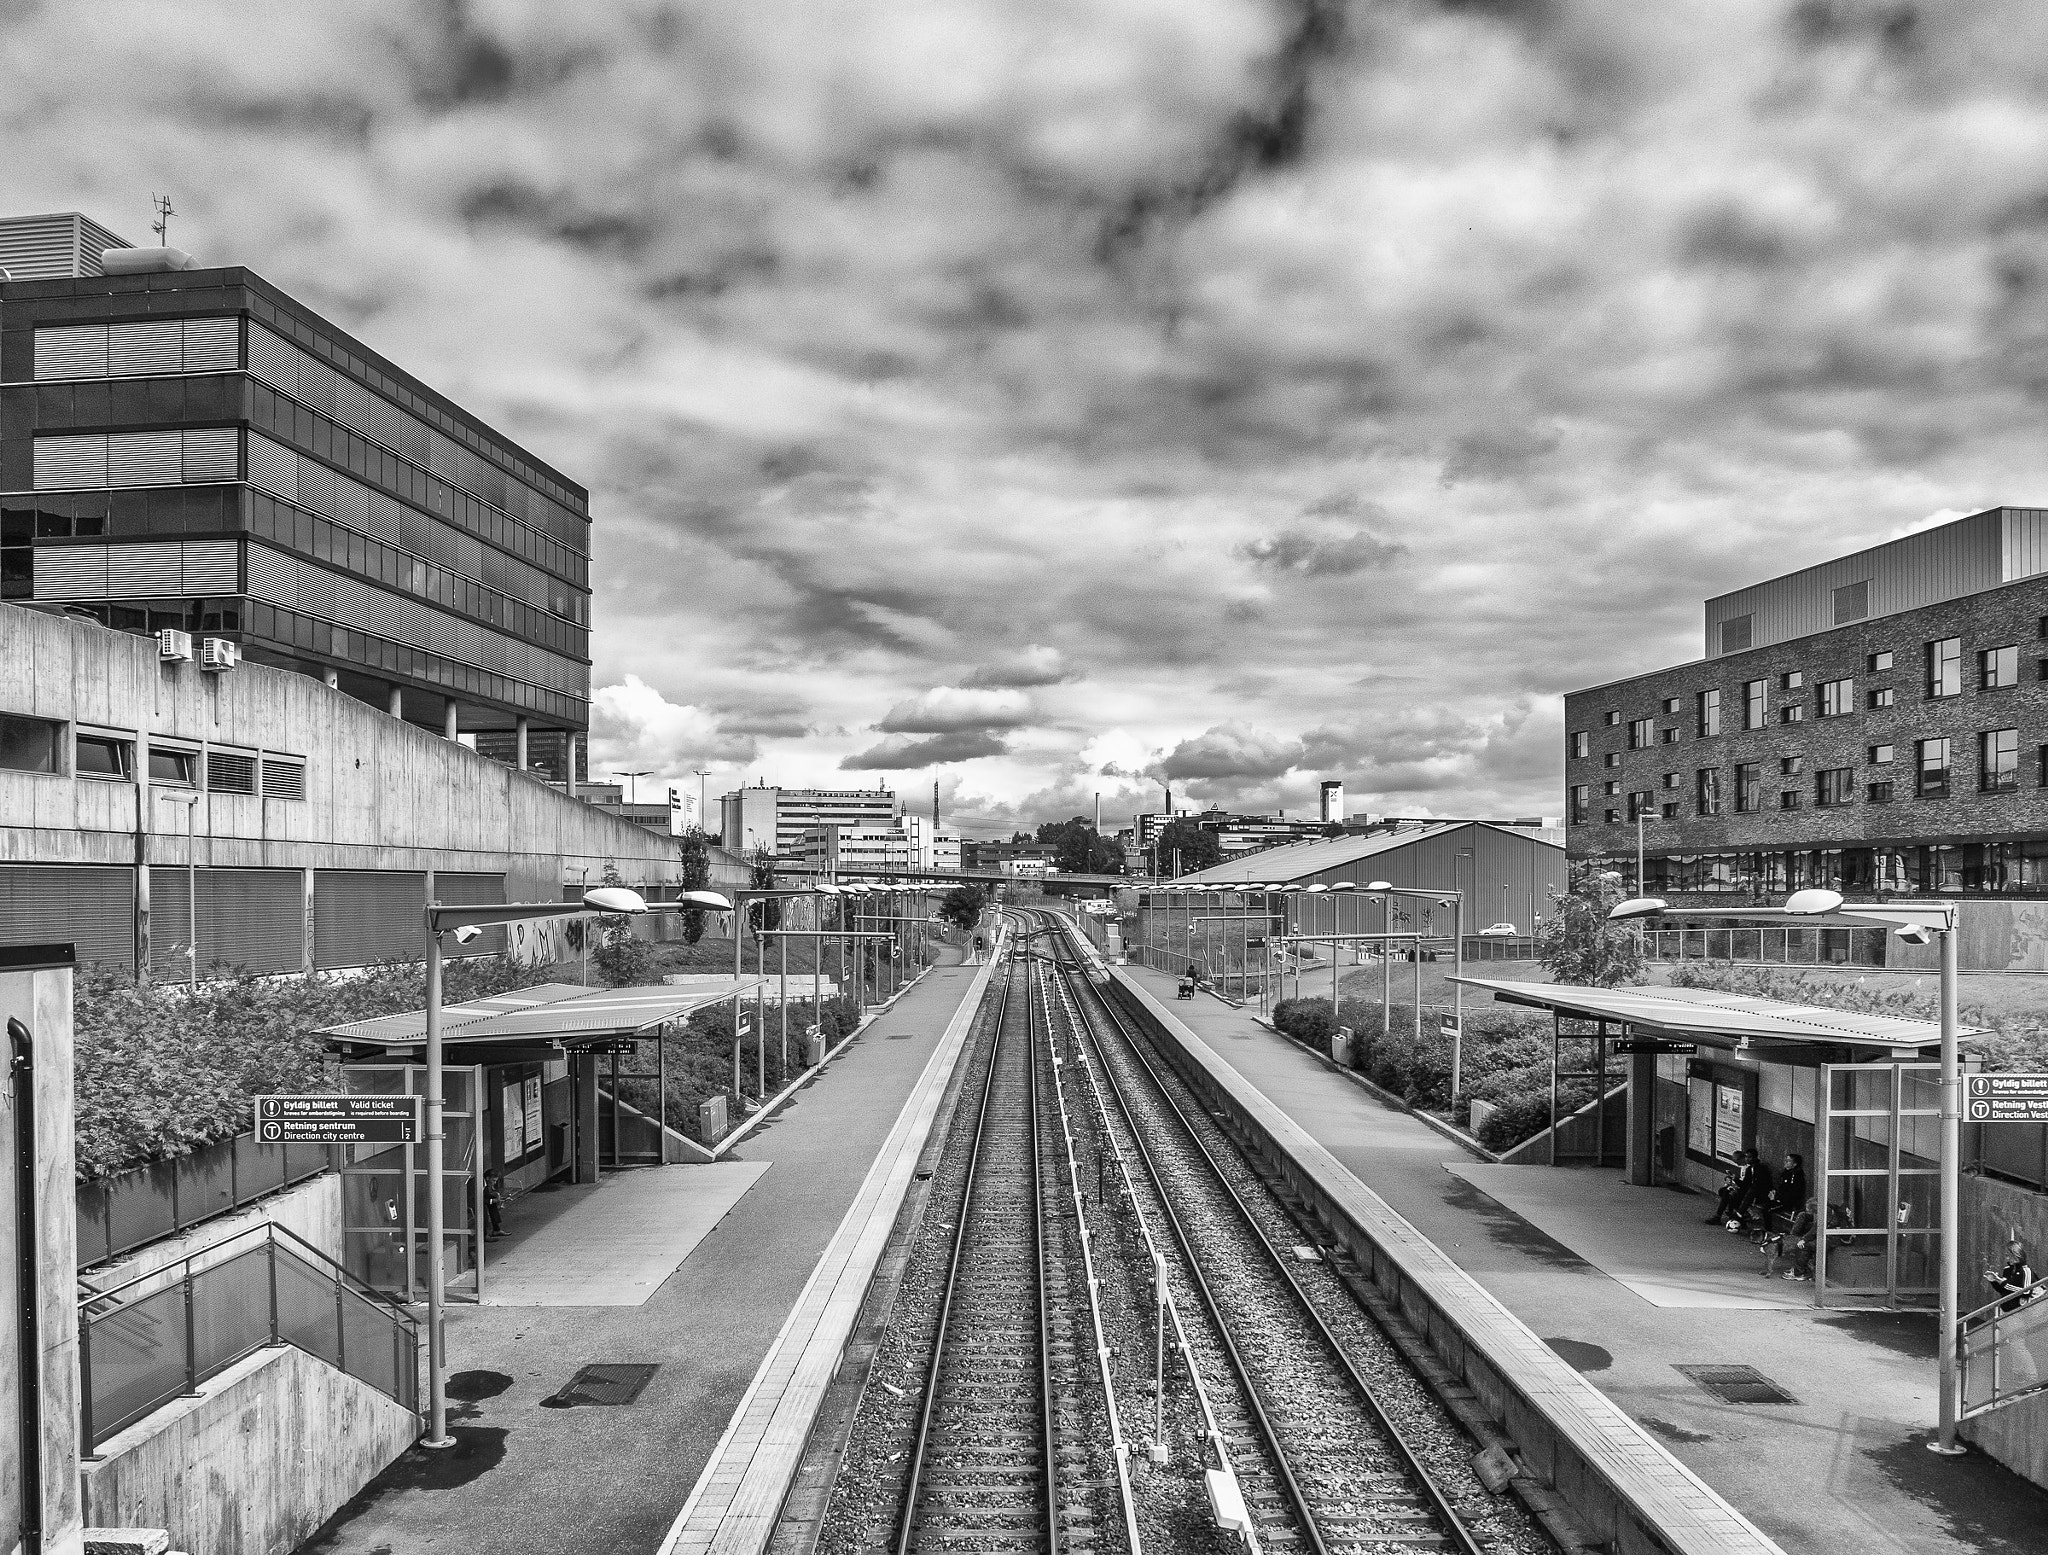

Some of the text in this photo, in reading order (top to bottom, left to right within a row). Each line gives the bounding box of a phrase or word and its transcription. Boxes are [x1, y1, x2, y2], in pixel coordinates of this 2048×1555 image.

[1993, 1079, 2048, 1089] Gyldig billett
[283, 1101, 339, 1111] Gyldig billett
[350, 1101, 394, 1109] Valid ticket
[1993, 1100, 2026, 1111] Retning
[1993, 1110, 2029, 1119] Direction
[284, 1121, 356, 1131] Retning sentrum
[284, 1131, 366, 1141] Direction city centre
